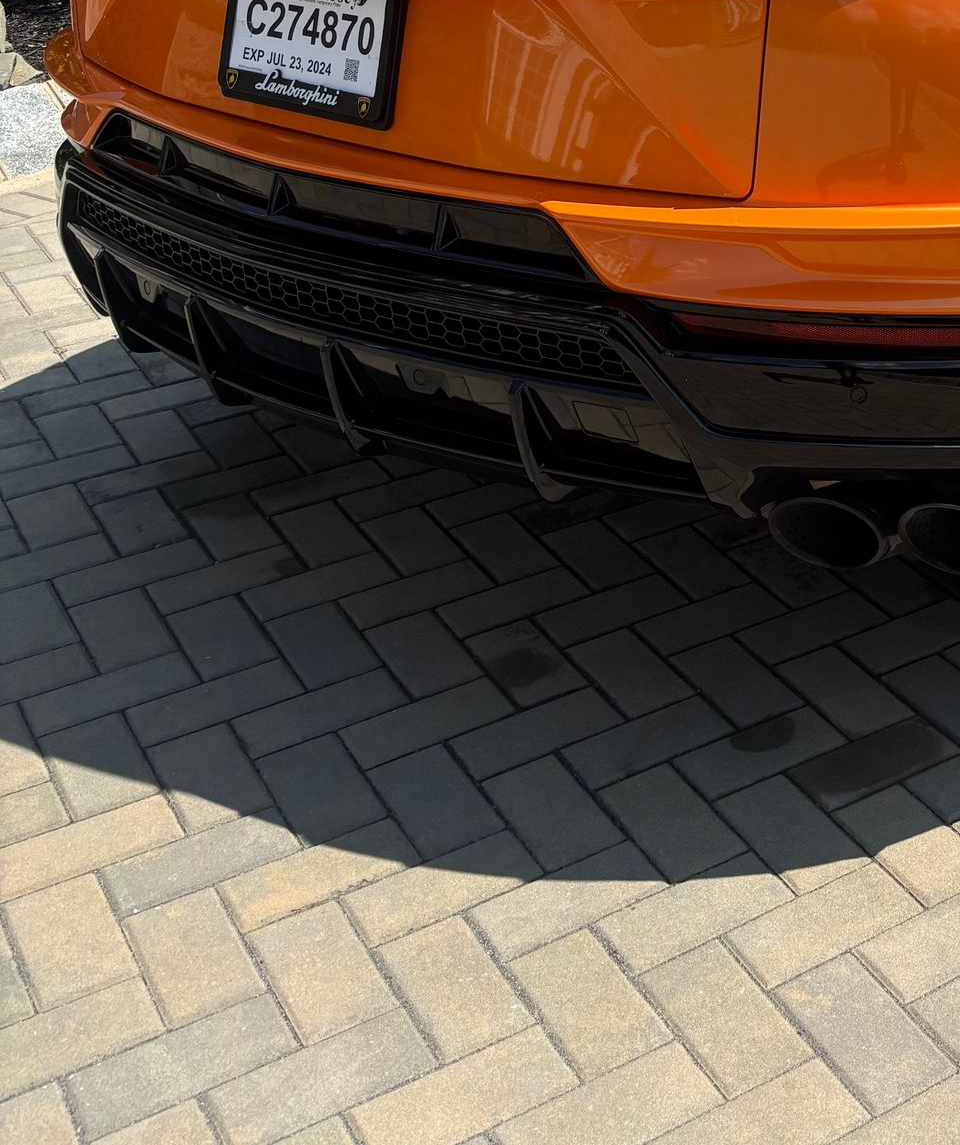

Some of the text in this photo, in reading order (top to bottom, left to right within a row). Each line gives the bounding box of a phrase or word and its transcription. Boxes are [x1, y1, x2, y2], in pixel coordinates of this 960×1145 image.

[242, 46, 332, 76] EXP JUL 23, 2024
[254, 69, 340, 106] Lamborghini
